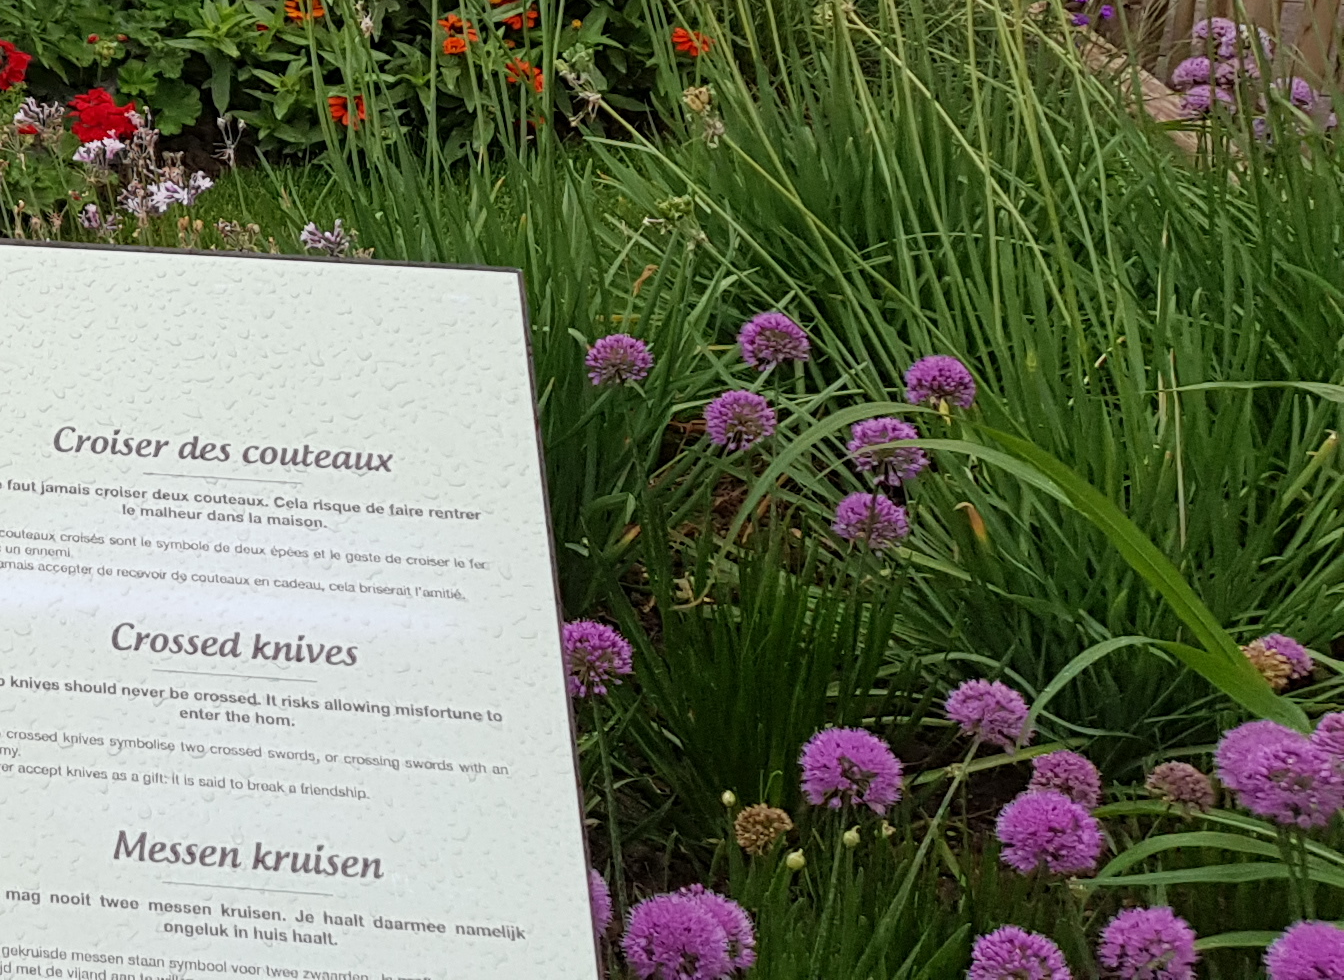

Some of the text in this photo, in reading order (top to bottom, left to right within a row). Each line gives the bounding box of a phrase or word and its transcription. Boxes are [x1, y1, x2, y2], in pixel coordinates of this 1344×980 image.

[52, 425, 393, 472] Croiser des couteaux
[6, 478, 37, 493] faut
[39, 480, 90, 496] jamais
[94, 485, 148, 499] croiser
[151, 487, 189, 502] deux
[192, 493, 269, 507] couteaux.
[272, 495, 308, 510] Cela
[312, 498, 361, 515] risque
[364, 501, 385, 515] de
[388, 502, 424, 517] faire
[427, 507, 481, 520] rentrer
[121, 502, 328, 531] le malheur dans la maison.
[36, 562, 93, 576] accepter
[96, 564, 113, 577] de
[115, 568, 167, 580] recevoir
[169, 569, 188, 584] de
[190, 572, 250, 586] couteaux
[253, 577, 270, 587] en
[272, 577, 325, 592] cadeau,
[328, 581, 356, 593] cela
[358, 581, 413, 598] briserait
[111, 621, 358, 666] Crossed knives
[9, 674, 60, 692] knives
[63, 679, 117, 695] should
[120, 685, 168, 702] never
[168, 685, 189, 700] be
[192, 691, 262, 707] crossed.
[265, 692, 277, 707] It
[280, 694, 320, 710] risks
[323, 697, 391, 718] allowing
[394, 703, 483, 722] misfortune
[485, 709, 503, 722] to
[178, 707, 295, 727] enter the hom.
[17, 764, 62, 778] accept
[65, 765, 108, 780] knives
[111, 771, 127, 781] as
[130, 772, 139, 782] a
[170, 771, 180, 785] it
[183, 773, 195, 786] is
[197, 776, 226, 789] said
[229, 777, 244, 790] to
[246, 778, 286, 793] break
[287, 784, 297, 794] a
[299, 782, 370, 801] friendship.
[112, 829, 384, 879] Messen kruisen
[4, 889, 41, 905] mag
[49, 891, 91, 906] nooit
[98, 894, 139, 910] twee
[147, 900, 212, 915] messen
[219, 902, 286, 921] kruisen.
[294, 908, 314, 924] Je
[322, 910, 365, 927] haalt
[372, 915, 446, 933] daarmee
[454, 924, 526, 942] namelijk
[163, 921, 338, 946] ongeluk in huis haalt.
